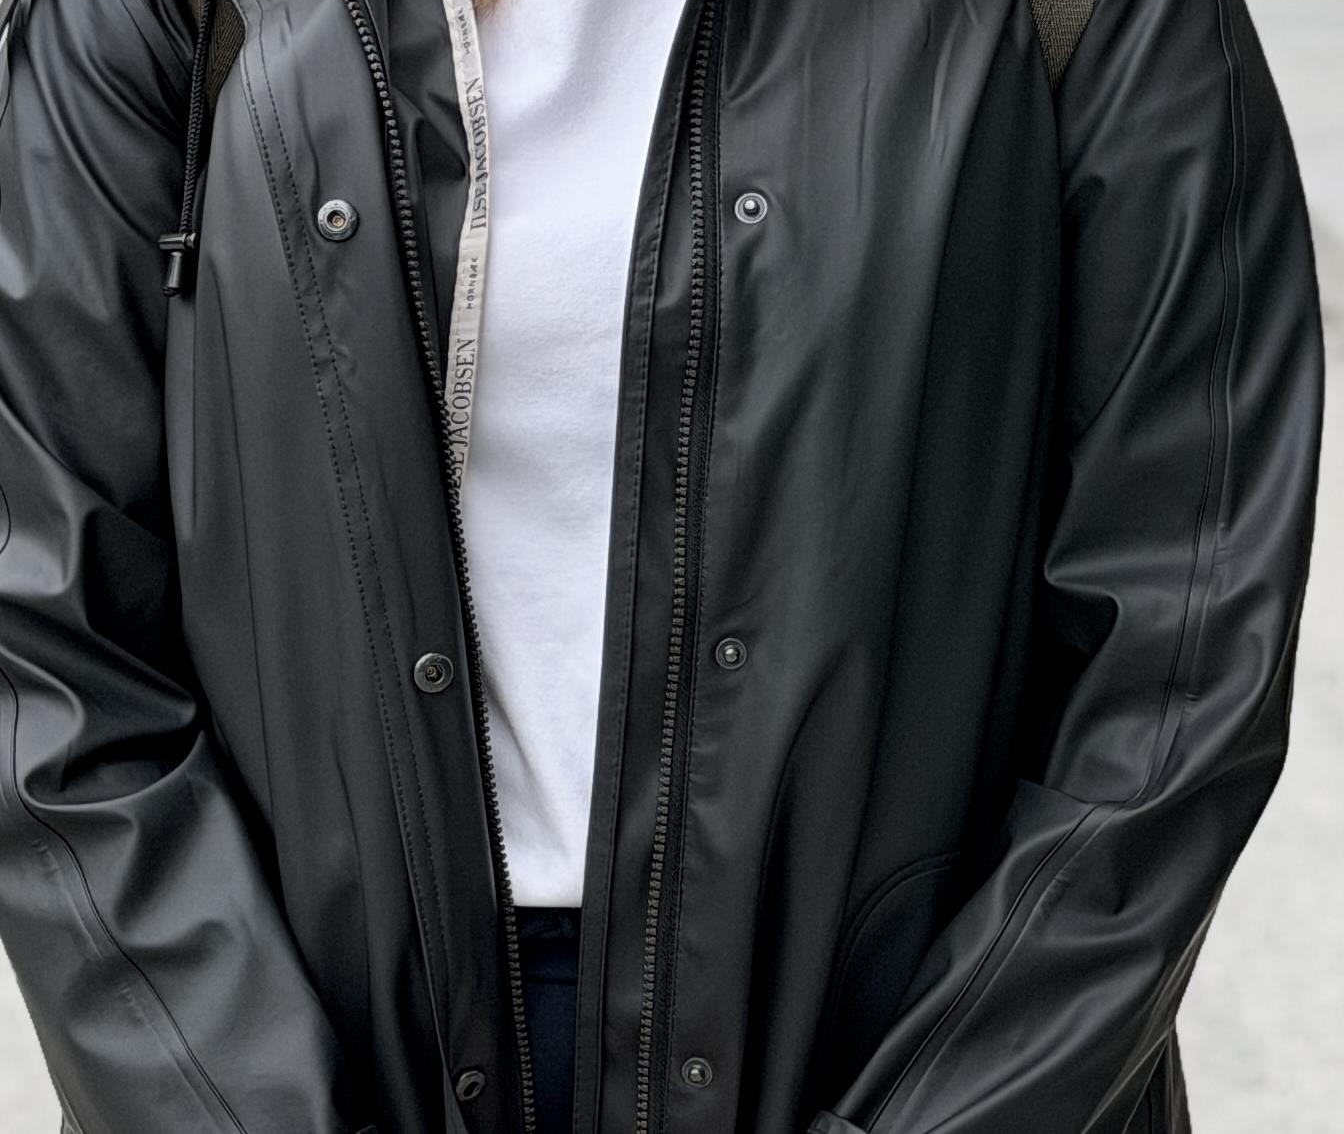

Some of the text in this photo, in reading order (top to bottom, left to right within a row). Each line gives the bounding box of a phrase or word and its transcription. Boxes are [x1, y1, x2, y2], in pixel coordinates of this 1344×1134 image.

[465, 77, 488, 231] ILSE JACOBSEN
[450, 338, 476, 448] JACOBSEN
